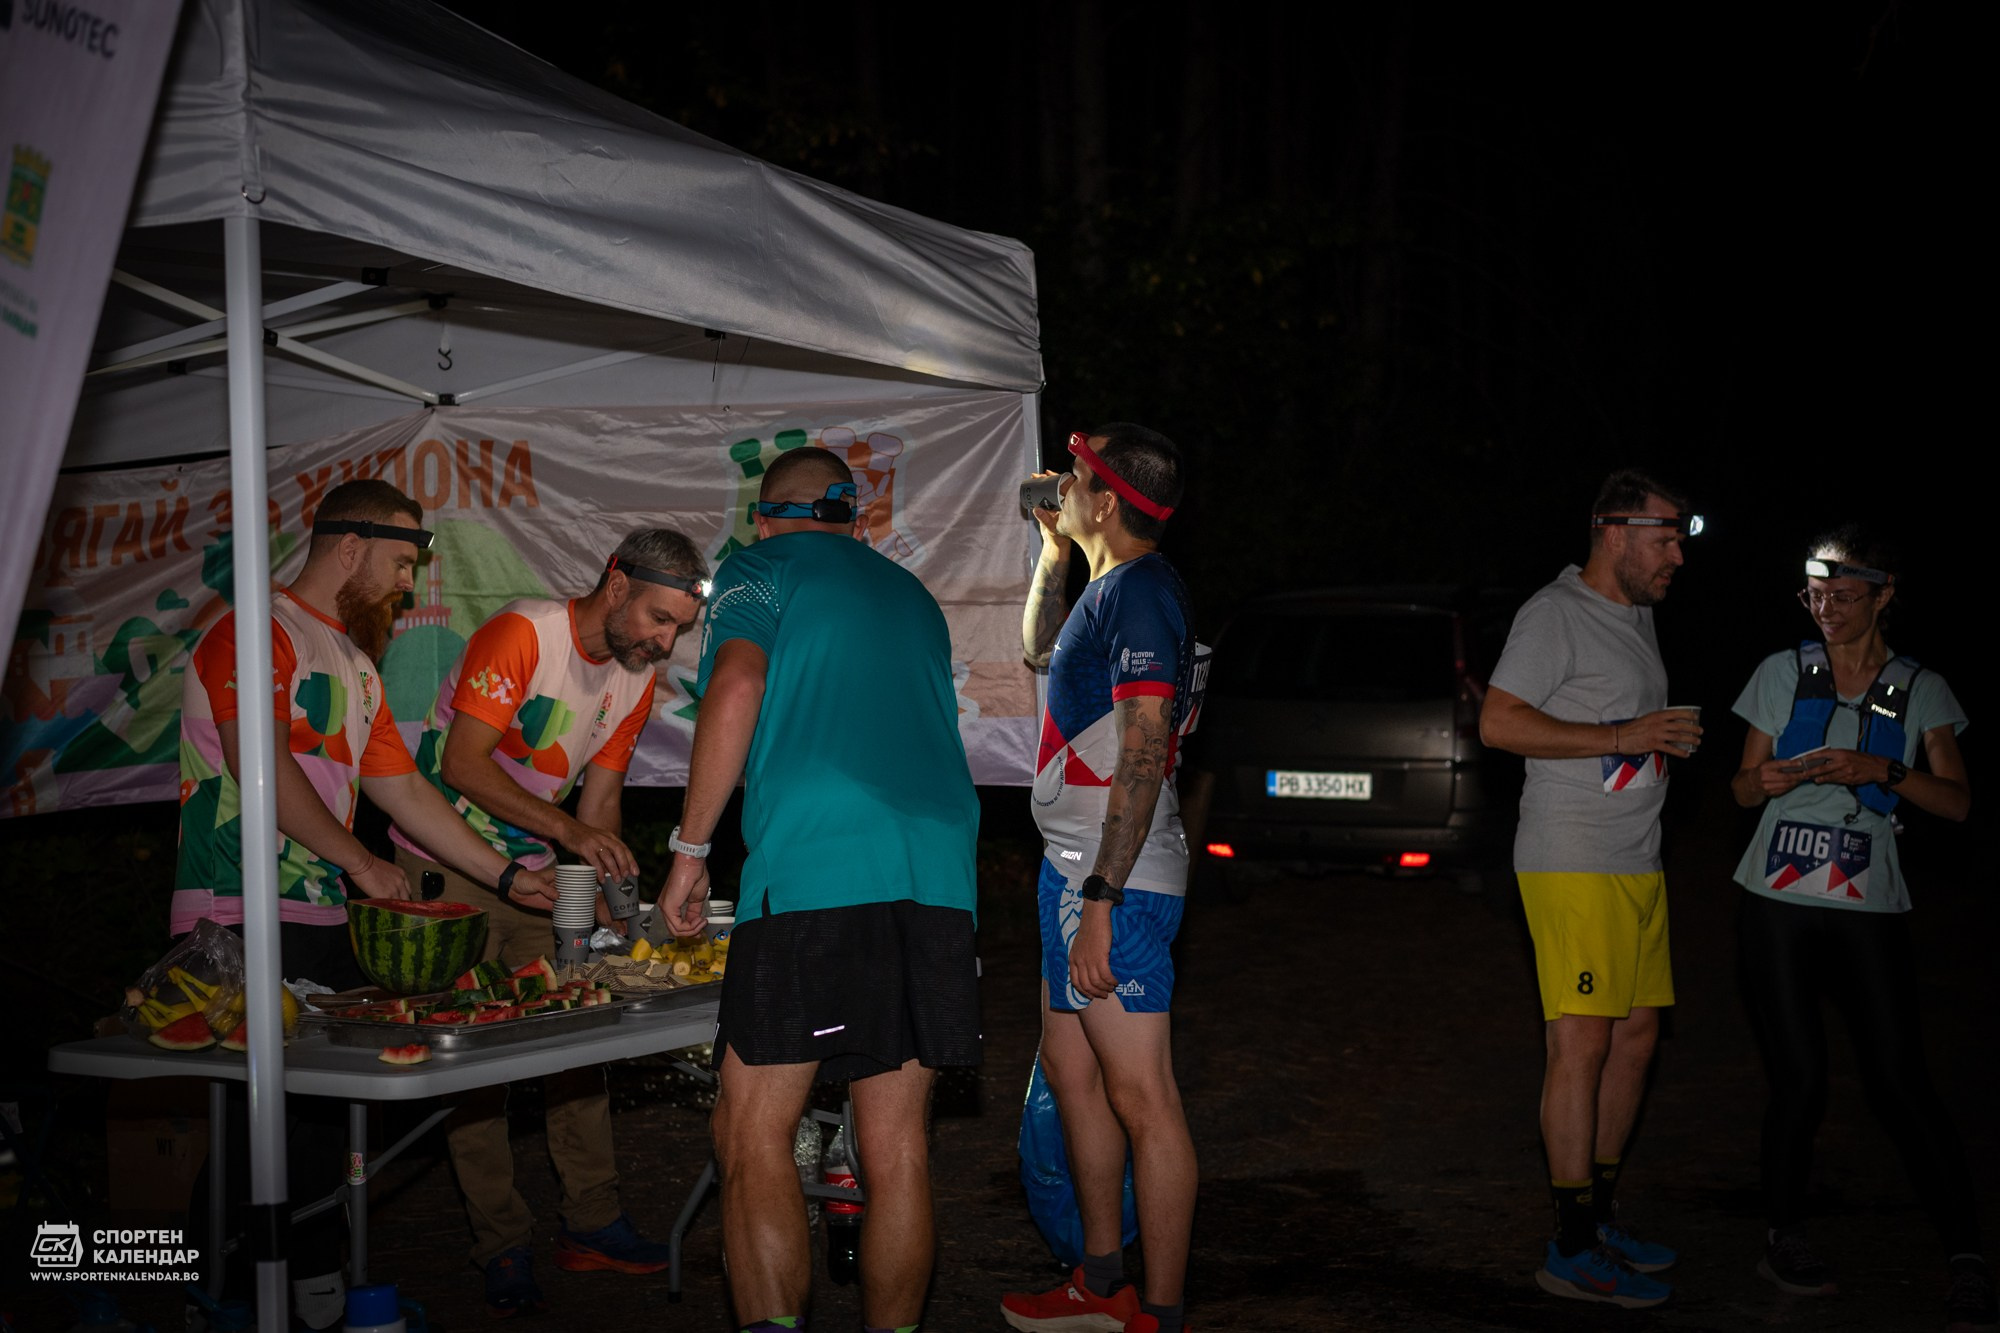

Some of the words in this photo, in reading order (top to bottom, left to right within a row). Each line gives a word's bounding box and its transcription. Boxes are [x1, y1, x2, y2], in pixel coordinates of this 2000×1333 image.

[36, 479, 192, 570] ЯГАЙ
[1777, 825, 1831, 860] 1106
[1578, 971, 1593, 994] 8
